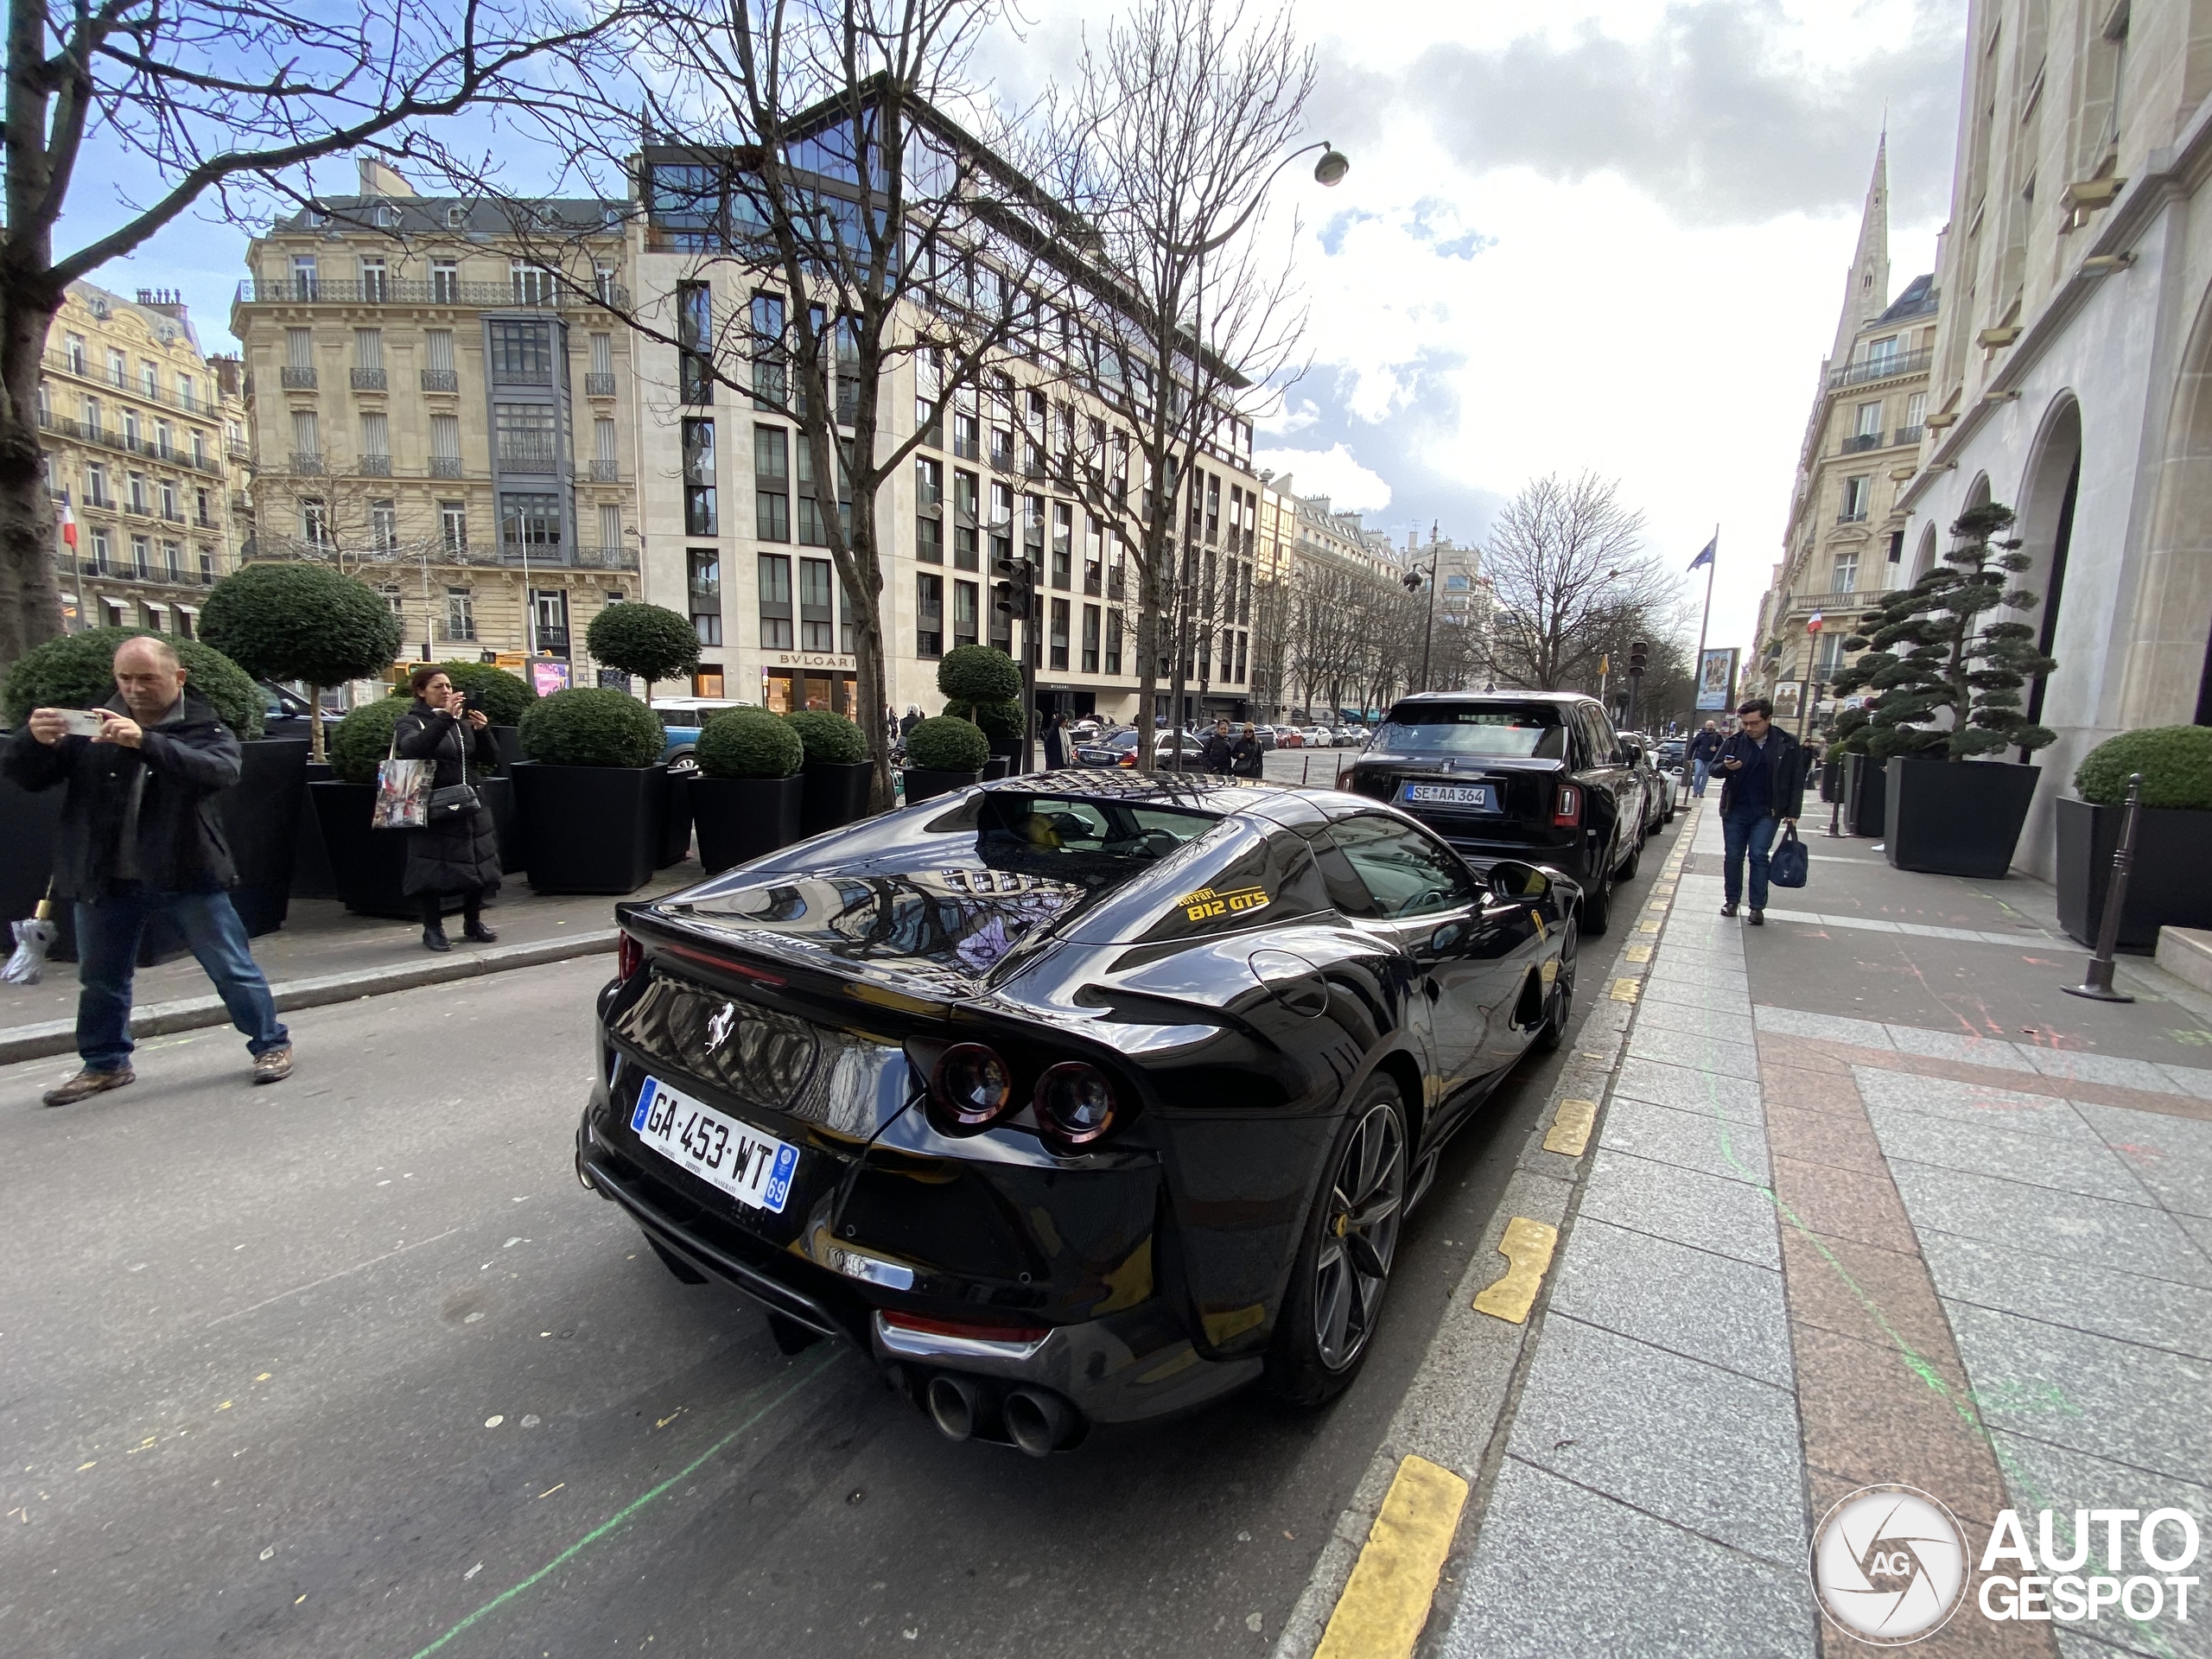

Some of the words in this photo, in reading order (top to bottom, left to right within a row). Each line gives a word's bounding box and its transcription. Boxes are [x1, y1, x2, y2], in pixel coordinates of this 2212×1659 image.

[780, 654, 855, 667] BVLGARI
[1414, 787, 1431, 799] SE
[1438, 788, 1455, 801] AA
[1458, 789, 1483, 803] 364
[1174, 887, 1217, 906] Ferrari
[1187, 899, 1227, 922] 812
[1229, 891, 1270, 911] GTS
[714, 1177, 736, 1194] MASERATI
[766, 1177, 786, 1203] 69
